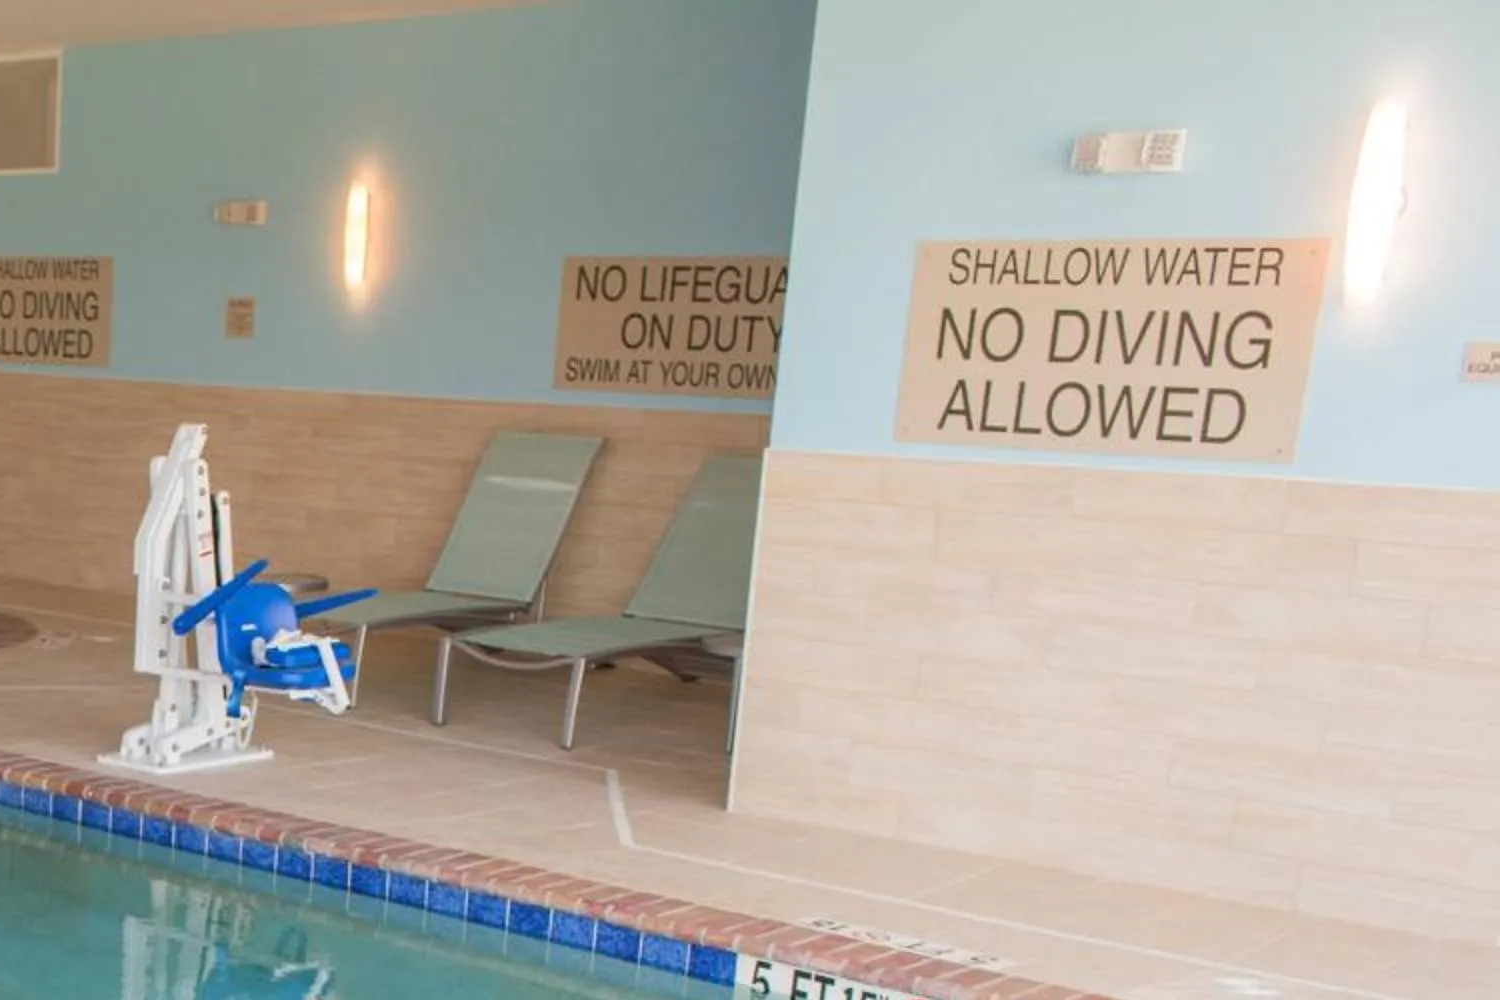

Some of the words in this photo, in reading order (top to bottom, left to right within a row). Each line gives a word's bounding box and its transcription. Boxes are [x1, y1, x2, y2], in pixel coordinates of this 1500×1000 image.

[52, 259, 100, 281] WATER
[576, 265, 627, 302] NO
[948, 247, 1130, 286] SHALLOW
[1145, 247, 1284, 287] WATER
[22, 290, 100, 322] DIVING
[621, 312, 674, 350] ON
[687, 314, 783, 353] DUTY
[936, 307, 1024, 363] NO
[1048, 309, 1273, 370] DIVING
[565, 356, 620, 383] SWIM
[626, 360, 652, 384] AT
[660, 361, 720, 388] YOUR
[937, 379, 1247, 445] ALLOWED
[751, 960, 772, 996] 5
